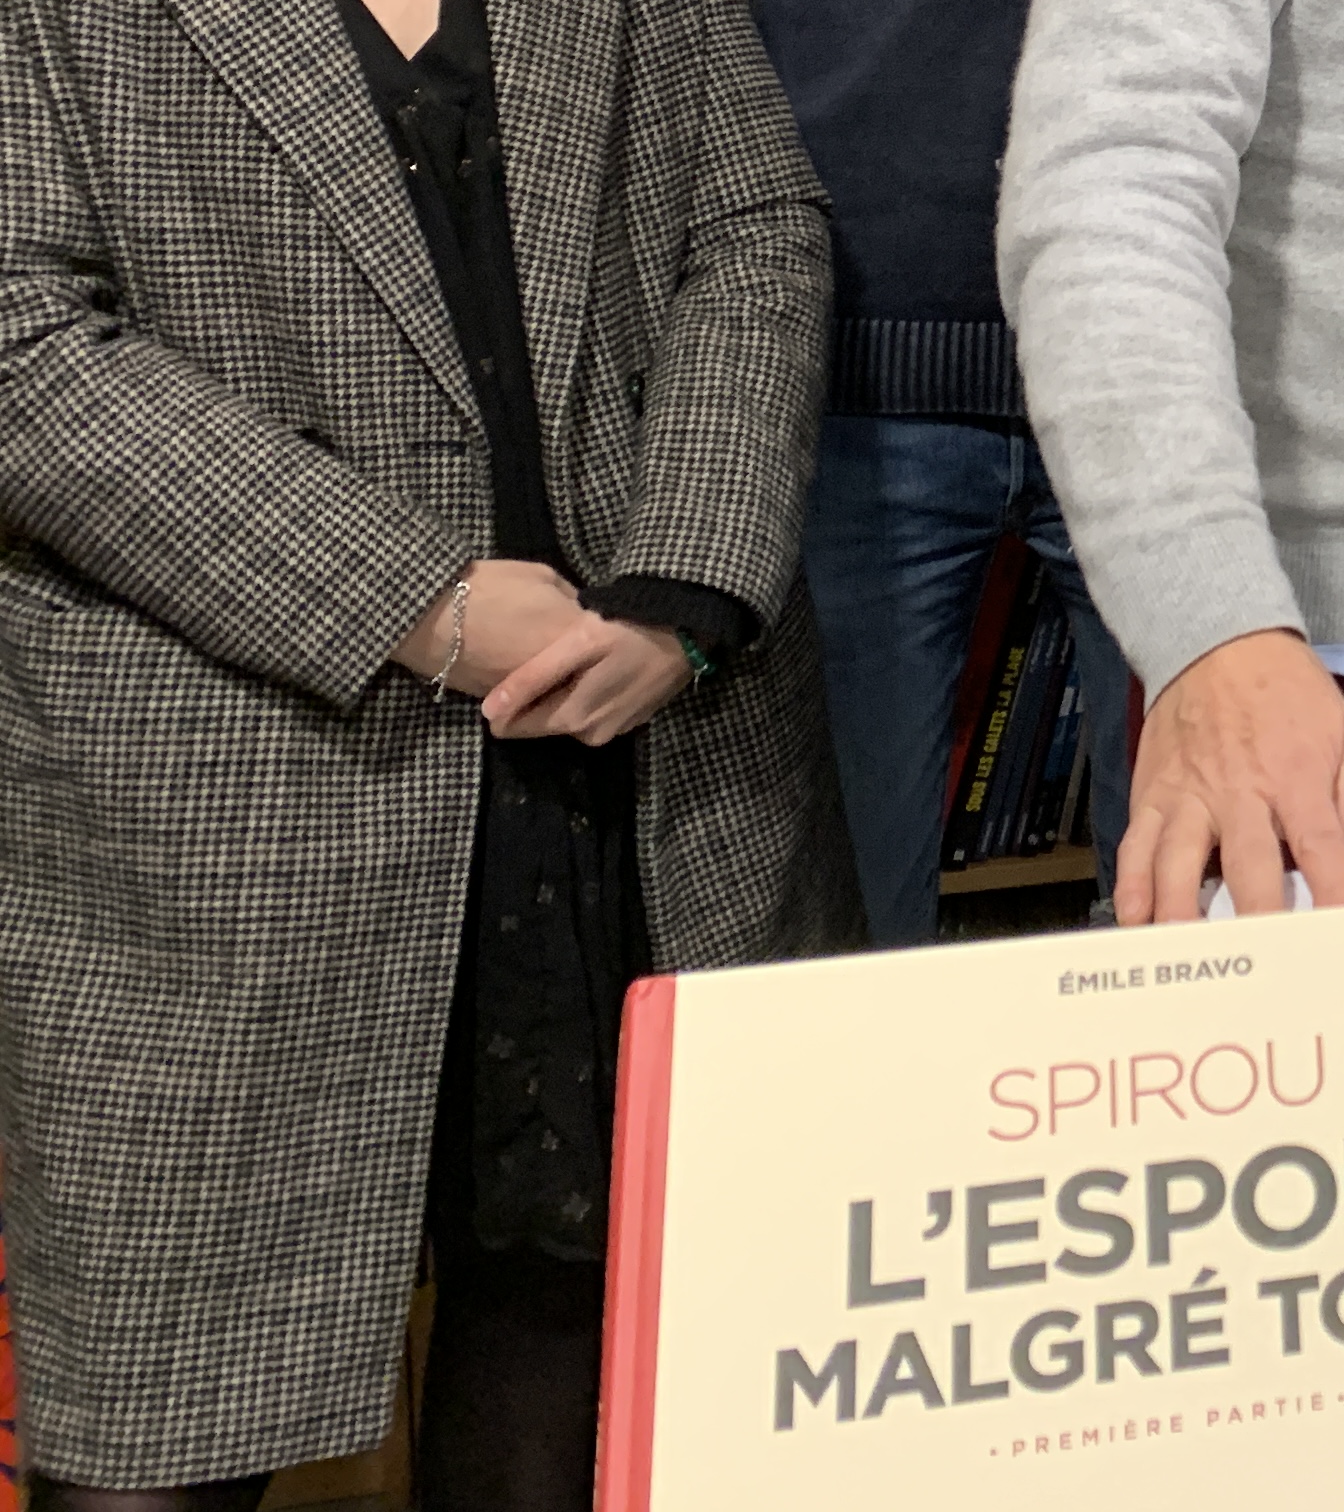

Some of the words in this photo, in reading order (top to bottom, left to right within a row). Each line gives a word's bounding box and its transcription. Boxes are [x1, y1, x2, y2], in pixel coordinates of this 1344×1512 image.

[1058, 966, 1147, 996] ÉMILE
[1154, 953, 1253, 987] BRAVO
[987, 1033, 1328, 1143] SPIROU
[773, 1269, 1231, 1431] MALGRÉ
[1010, 1415, 1185, 1458] PREMIÈRE
[1205, 1392, 1326, 1429] PARTIE
